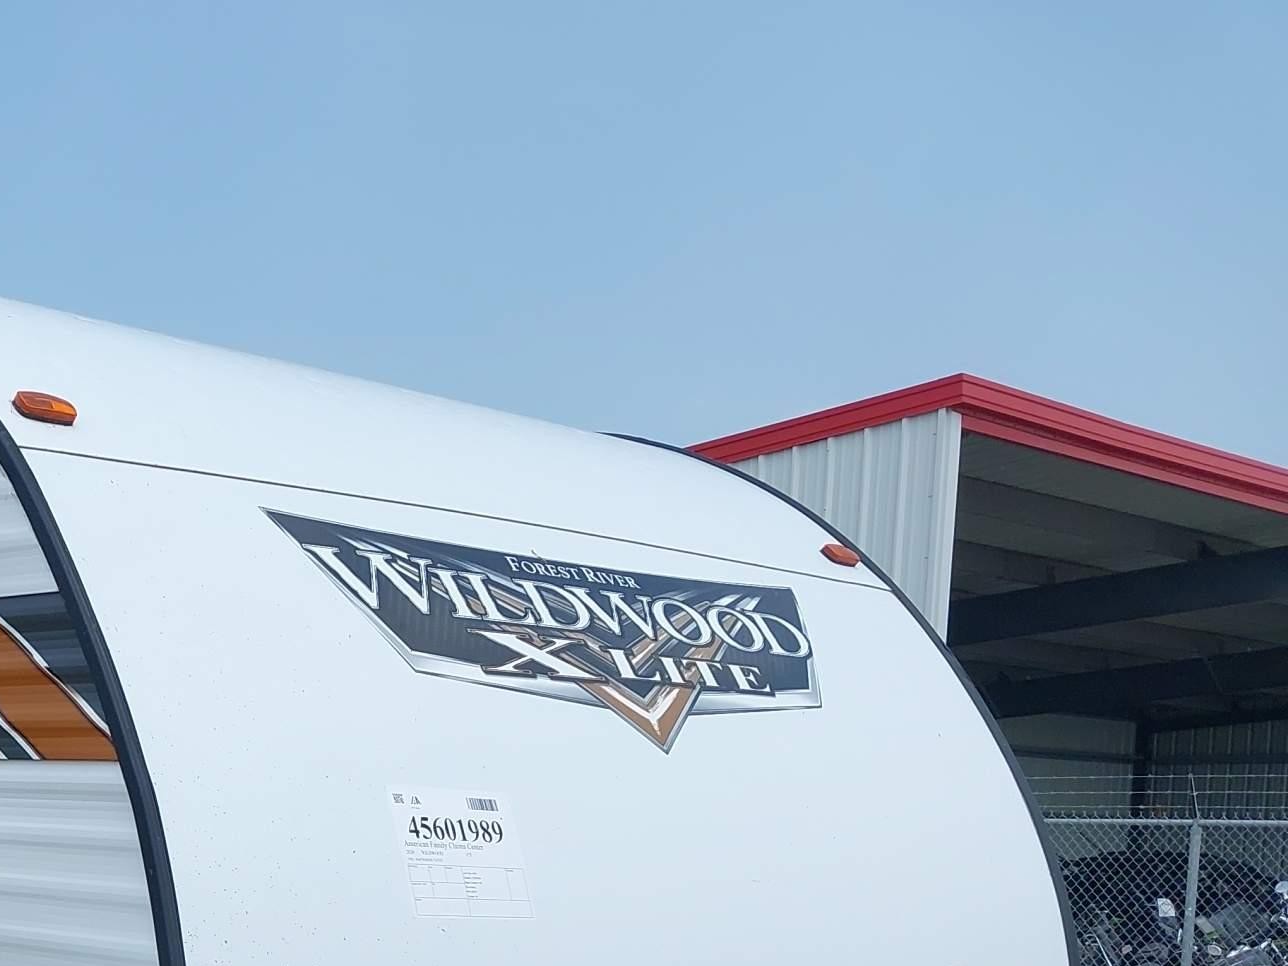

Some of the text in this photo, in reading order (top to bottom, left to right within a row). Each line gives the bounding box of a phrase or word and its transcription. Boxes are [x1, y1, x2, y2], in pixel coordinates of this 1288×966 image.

[506, 555, 640, 589] FOREST RIVER
[302, 541, 813, 659] WILDWOOD
[468, 627, 775, 694] X LITE
[408, 815, 504, 844] 45601989
